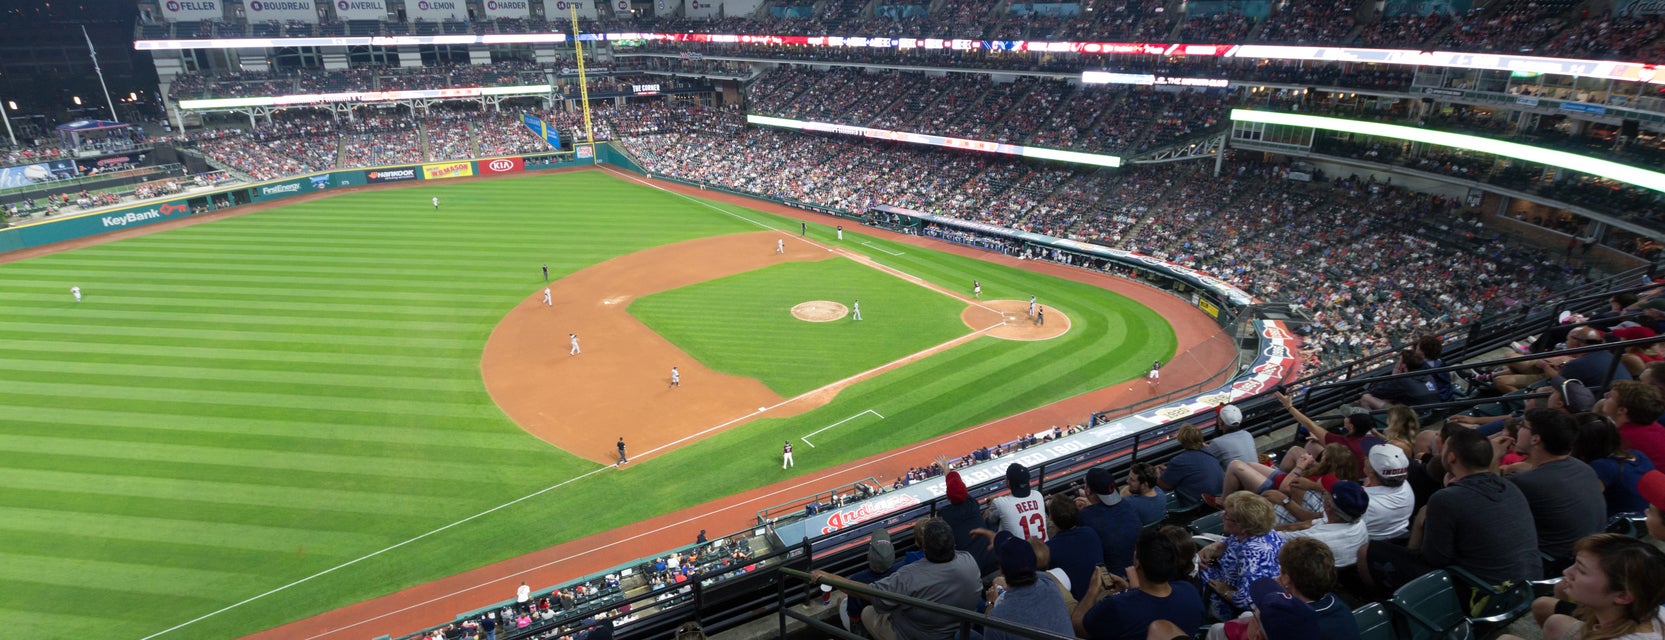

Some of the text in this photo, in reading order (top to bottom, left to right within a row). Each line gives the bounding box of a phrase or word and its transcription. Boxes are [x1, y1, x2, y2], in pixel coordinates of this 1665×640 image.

[180, 2, 216, 11] FELLER
[263, 1, 310, 10] BOUDREAU
[350, 1, 384, 10] AVERILL
[429, 2, 455, 10] LEMON
[498, 2, 526, 10] HARDER
[642, 84, 660, 92] CORNER
[492, 160, 511, 170] KIA
[262, 183, 301, 195] FirstEnergy
[102, 209, 160, 227] KeyBank
[1015, 499, 1039, 514] REED
[822, 493, 919, 535] Indians
[1019, 513, 1046, 543] 13
